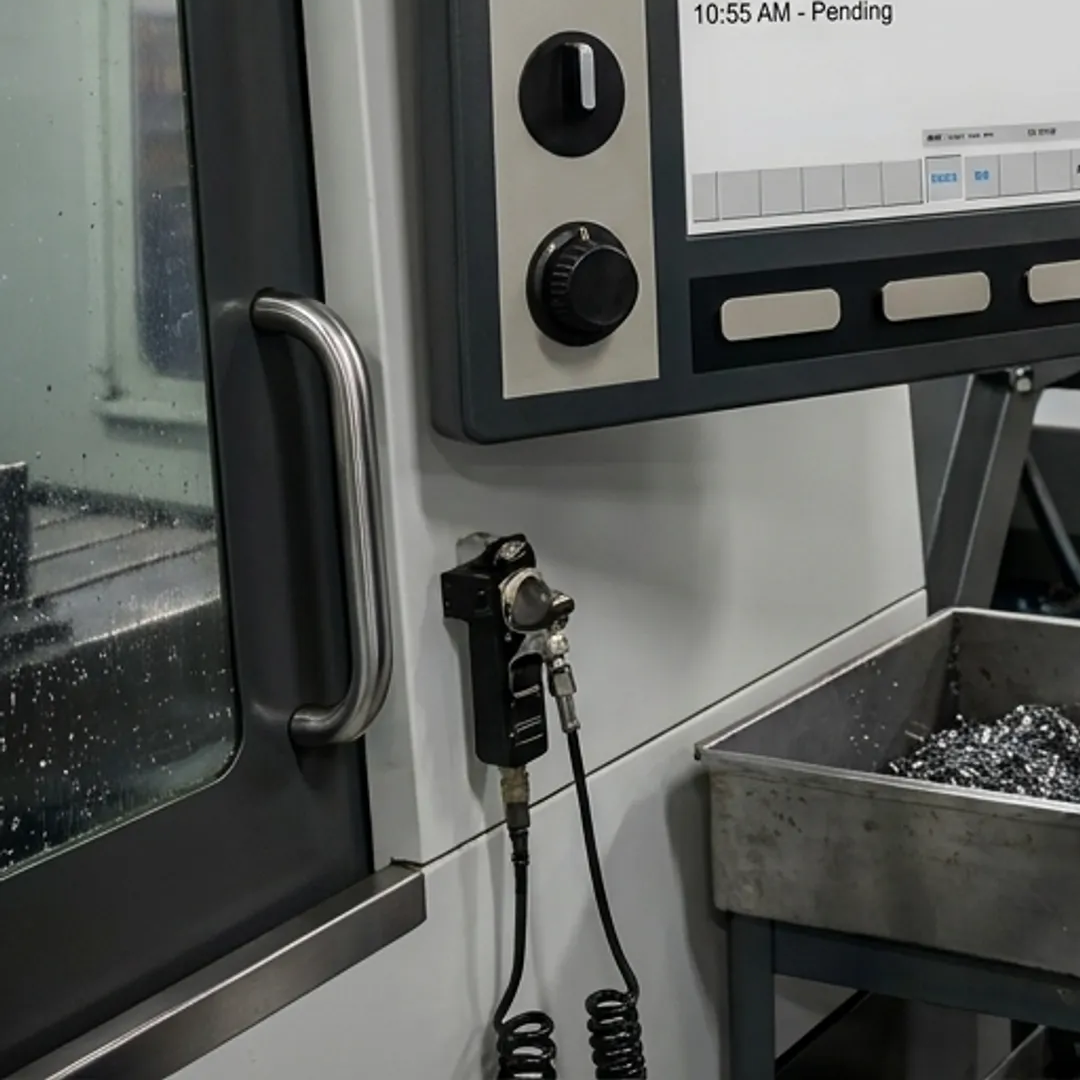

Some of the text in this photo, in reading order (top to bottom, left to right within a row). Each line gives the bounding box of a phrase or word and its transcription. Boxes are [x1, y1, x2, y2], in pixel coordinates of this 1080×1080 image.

[694, 2, 752, 25] 10:55
[756, 2, 791, 24] AM
[811, 1, 893, 25] Pending
